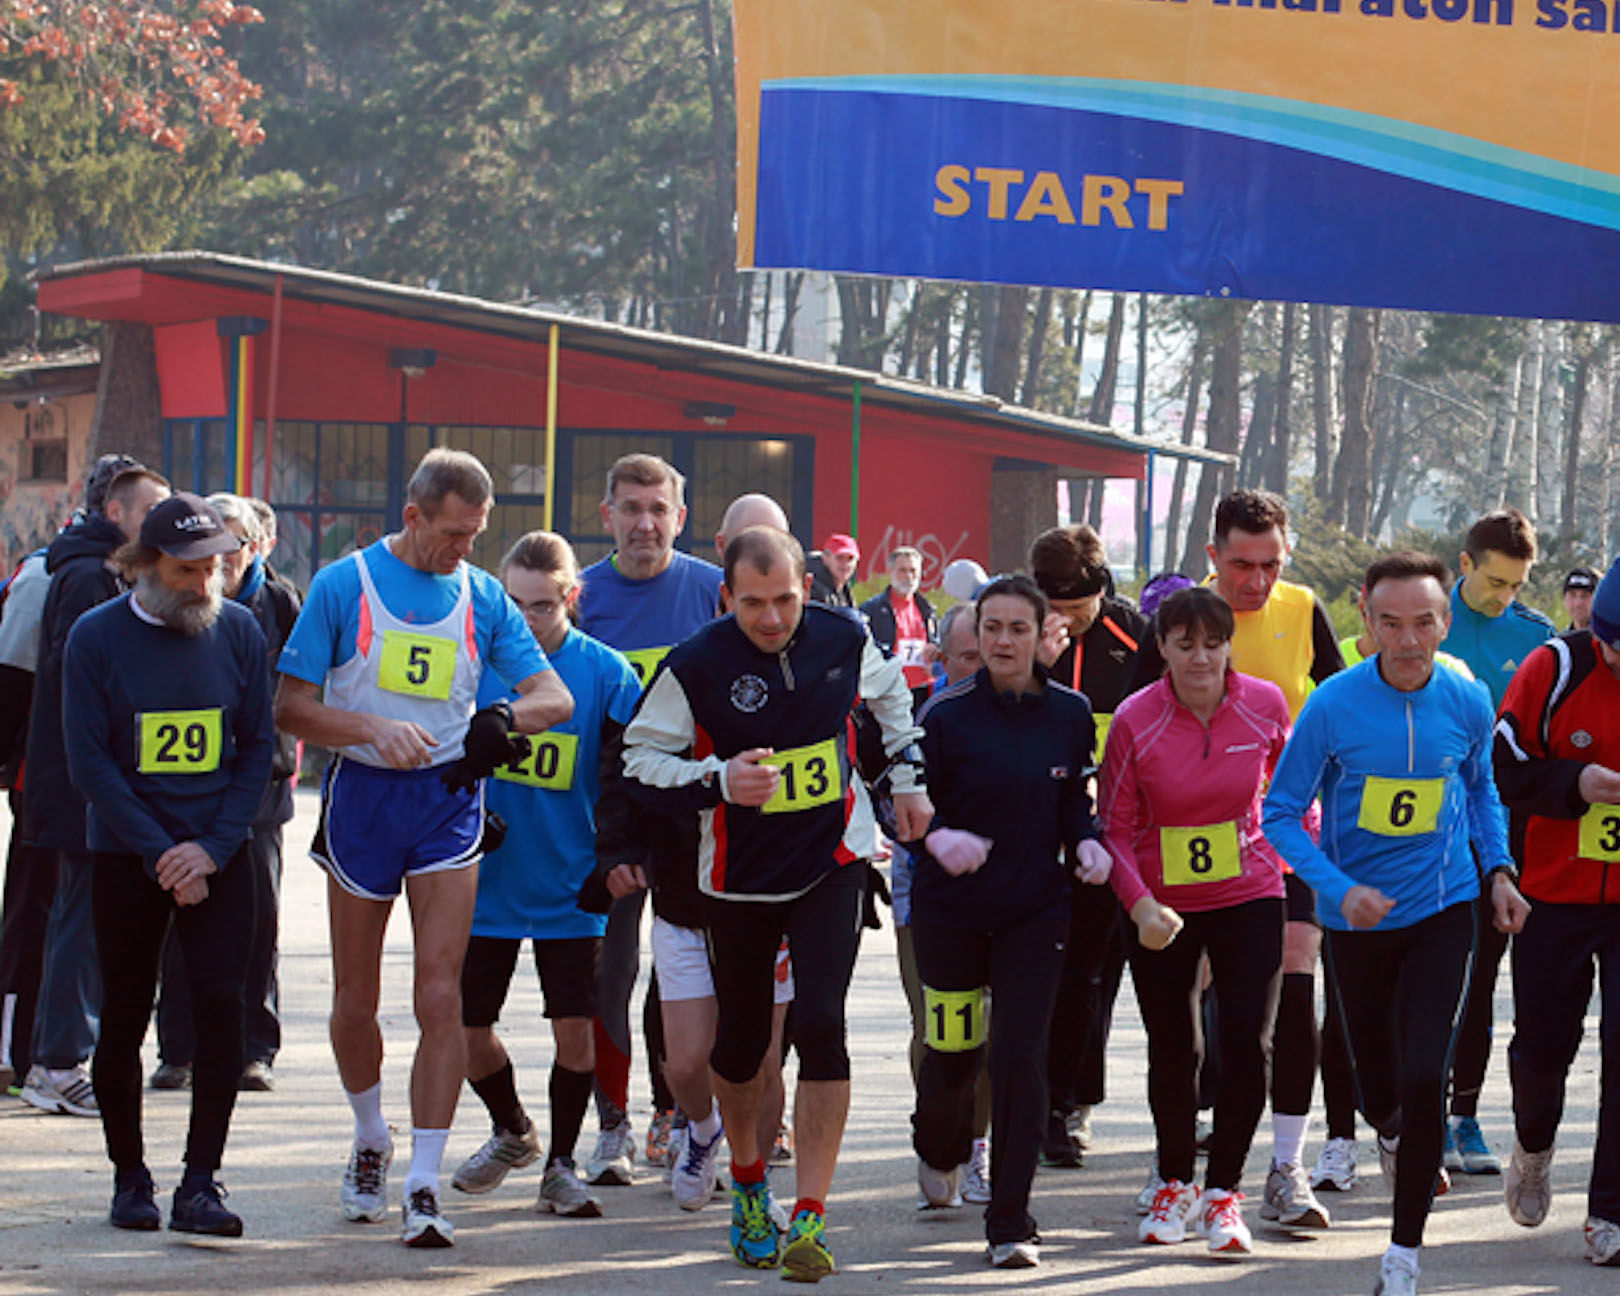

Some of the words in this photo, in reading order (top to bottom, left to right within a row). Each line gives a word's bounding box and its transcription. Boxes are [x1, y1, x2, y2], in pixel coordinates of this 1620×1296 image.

[1212, 0, 1513, 25] aton
[934, 164, 1184, 231] START
[406, 646, 432, 685] 5
[156, 723, 206, 763] 29
[781, 757, 829, 801] 13
[1390, 790, 1417, 827] 6
[1189, 837, 1212, 873] 8
[932, 1003, 972, 1041] 11
